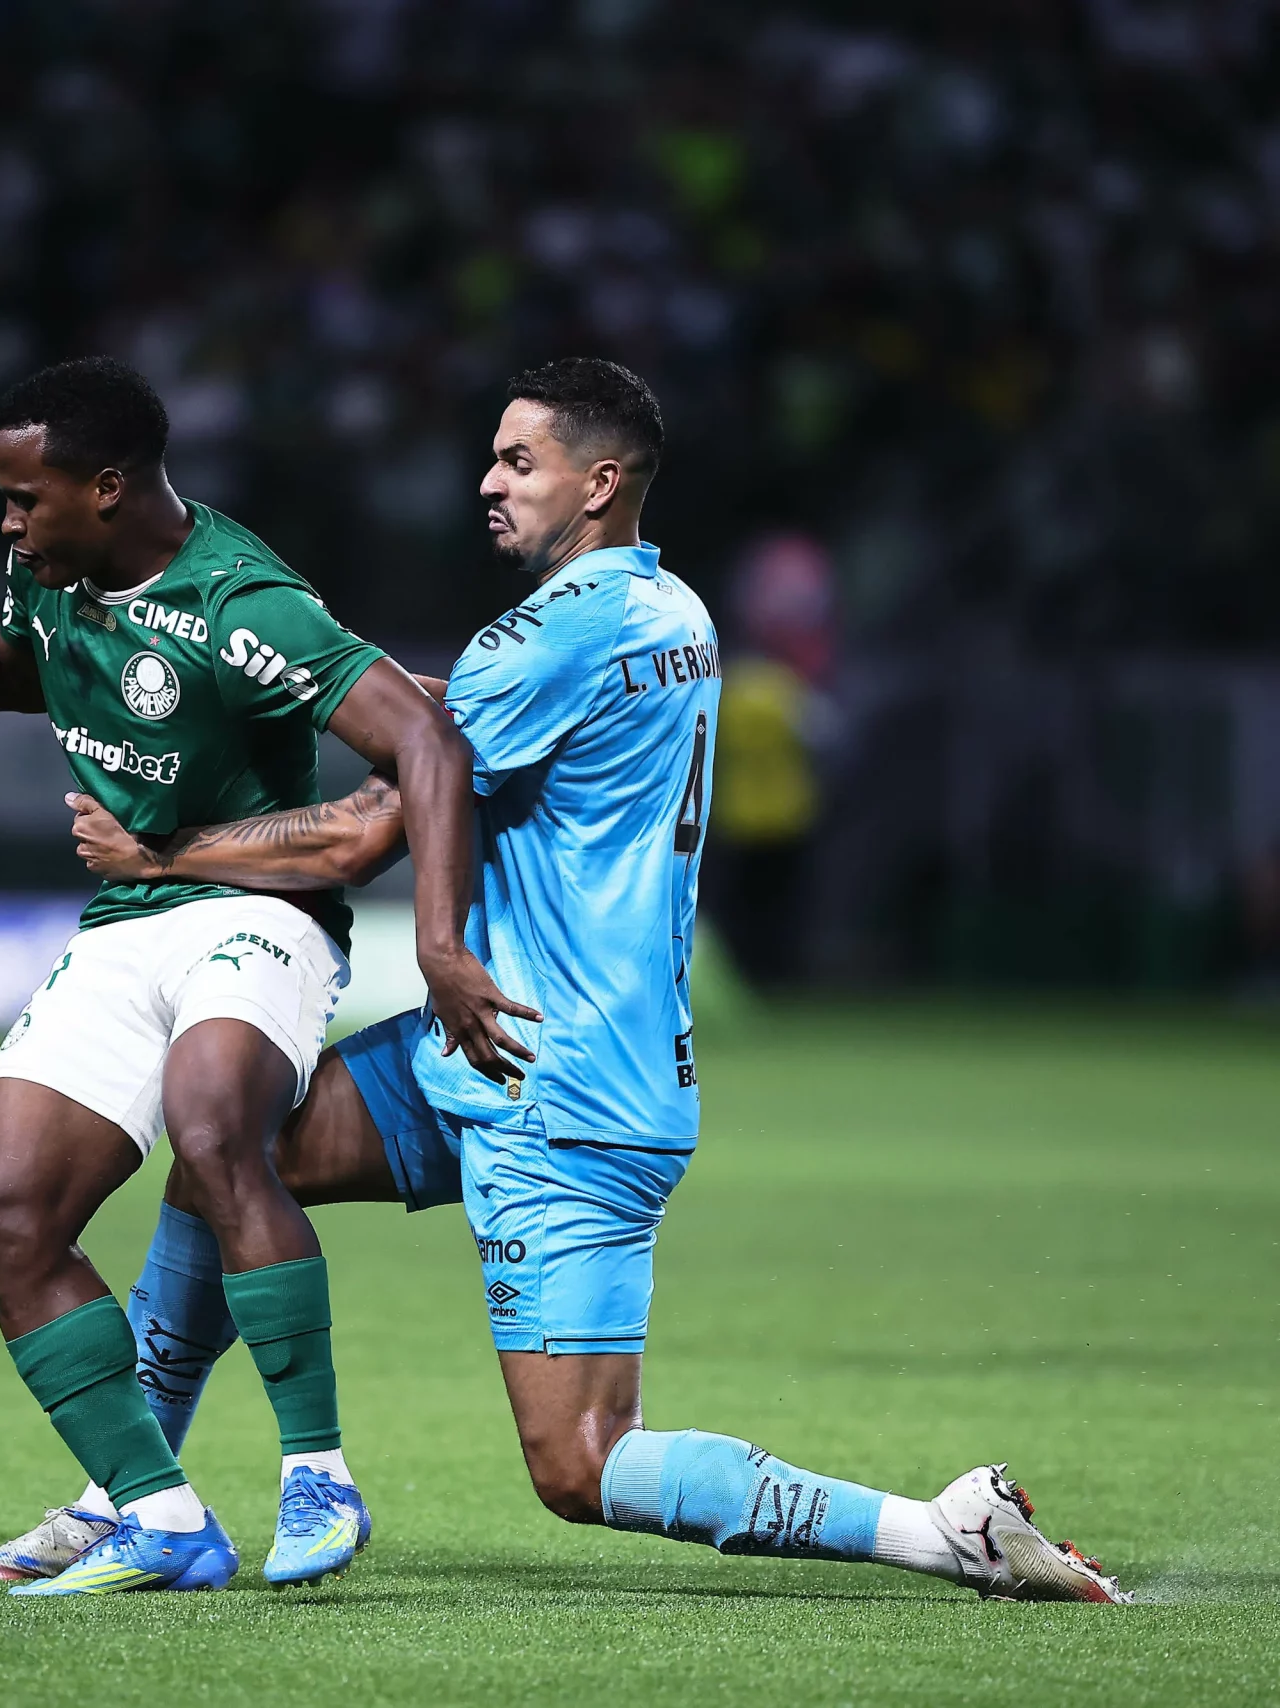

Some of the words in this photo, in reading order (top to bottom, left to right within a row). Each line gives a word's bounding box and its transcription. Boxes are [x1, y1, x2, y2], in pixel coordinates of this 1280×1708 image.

[128, 599, 209, 644] CIMED
[123, 676, 177, 716] PALMEIRAS
[621, 659, 647, 695] L.
[673, 709, 706, 857] 4
[489, 1305, 517, 1317] umbro
